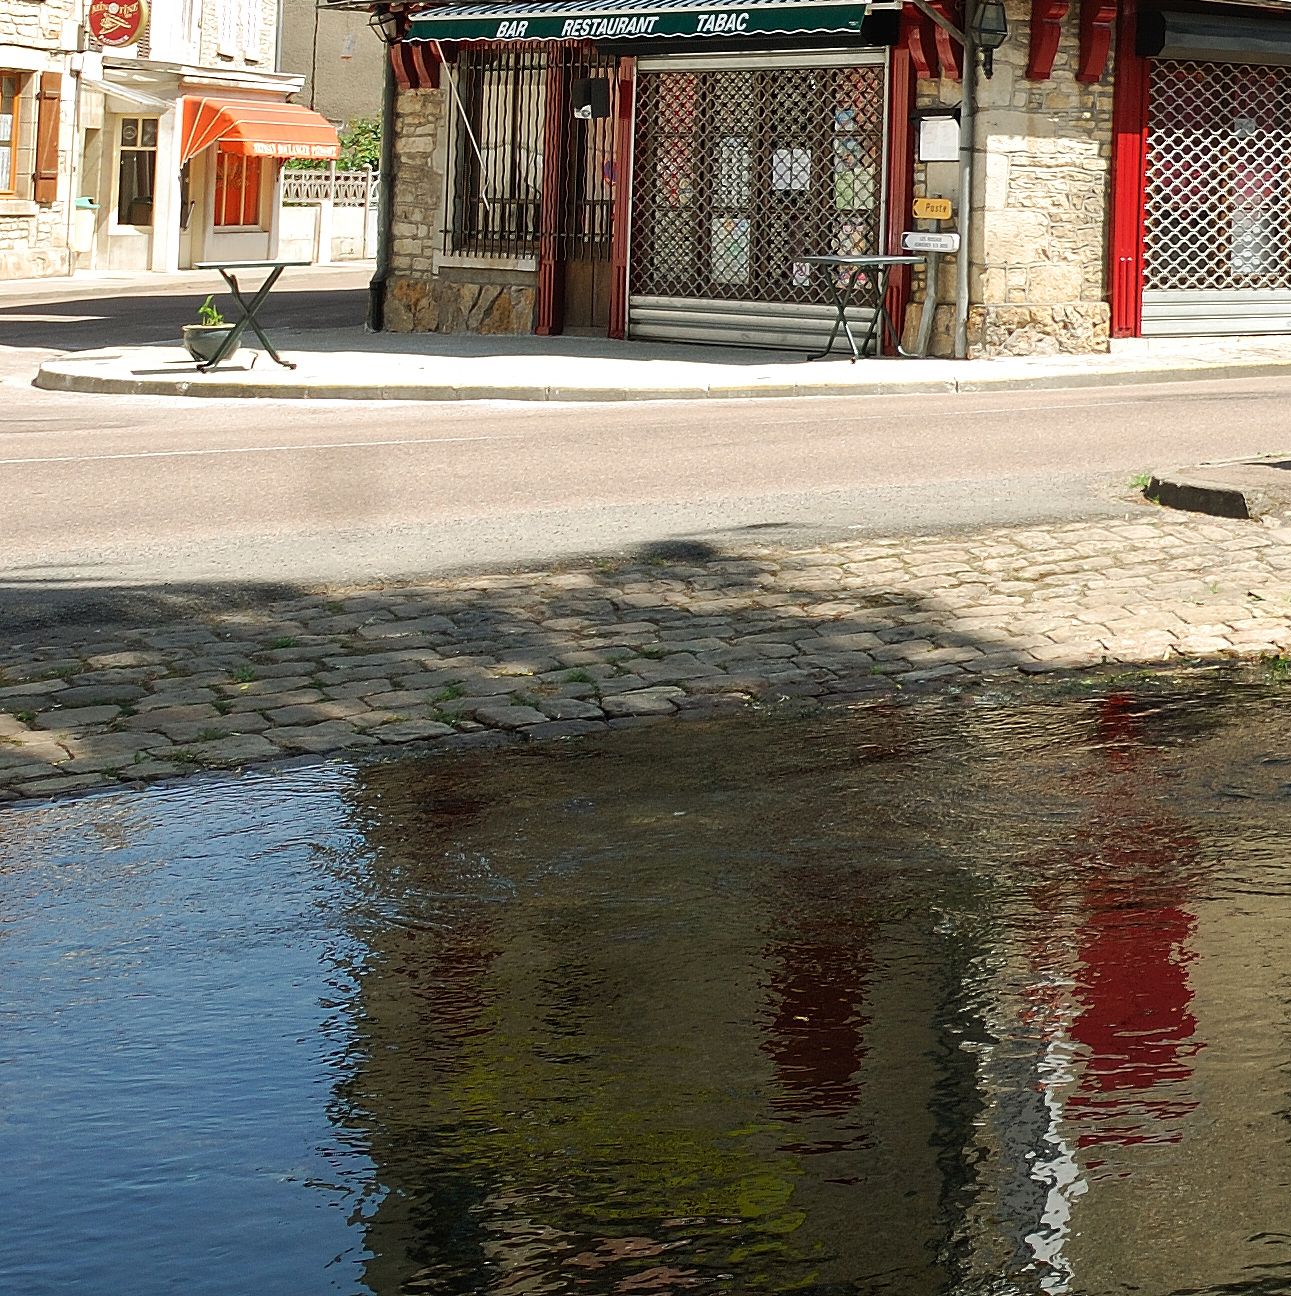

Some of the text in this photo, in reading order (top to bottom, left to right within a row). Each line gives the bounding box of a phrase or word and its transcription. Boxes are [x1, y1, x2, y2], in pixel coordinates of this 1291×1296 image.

[496, 13, 749, 38] BAR RESTAURANT TABAC
[925, 203, 947, 213] Poste
